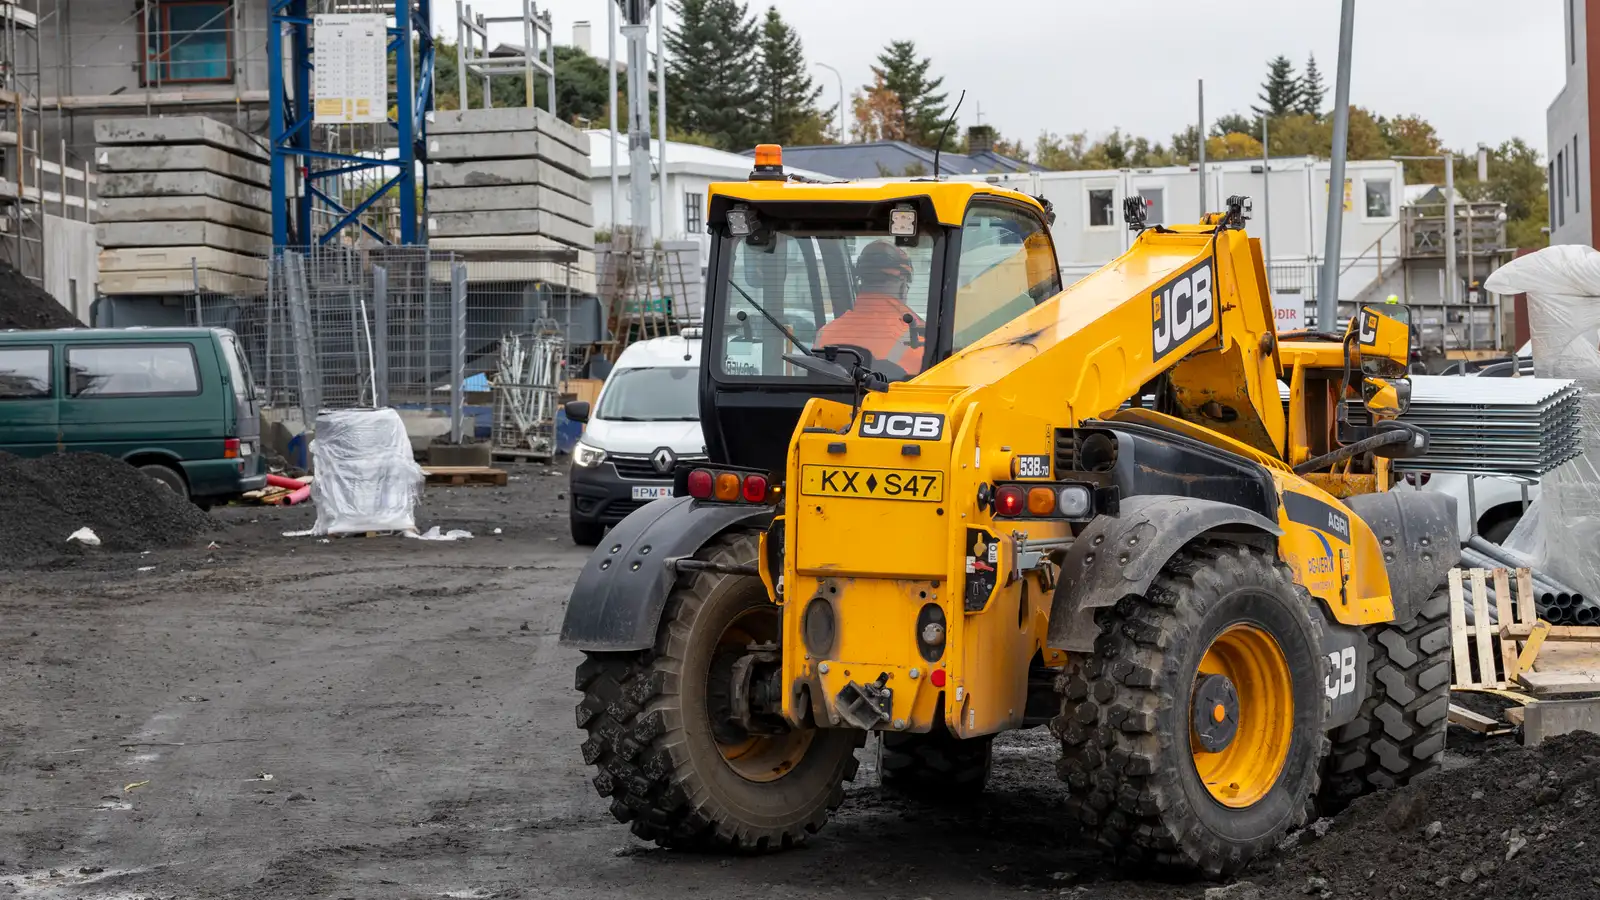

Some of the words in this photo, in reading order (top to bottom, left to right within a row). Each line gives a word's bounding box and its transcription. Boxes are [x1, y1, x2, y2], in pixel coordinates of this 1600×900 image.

[1154, 265, 1212, 353] JCB
[863, 414, 940, 438] JCB
[1020, 456, 1049, 476] 538-70
[1328, 512, 1348, 536] AGRI
[1325, 646, 1356, 699] CB
